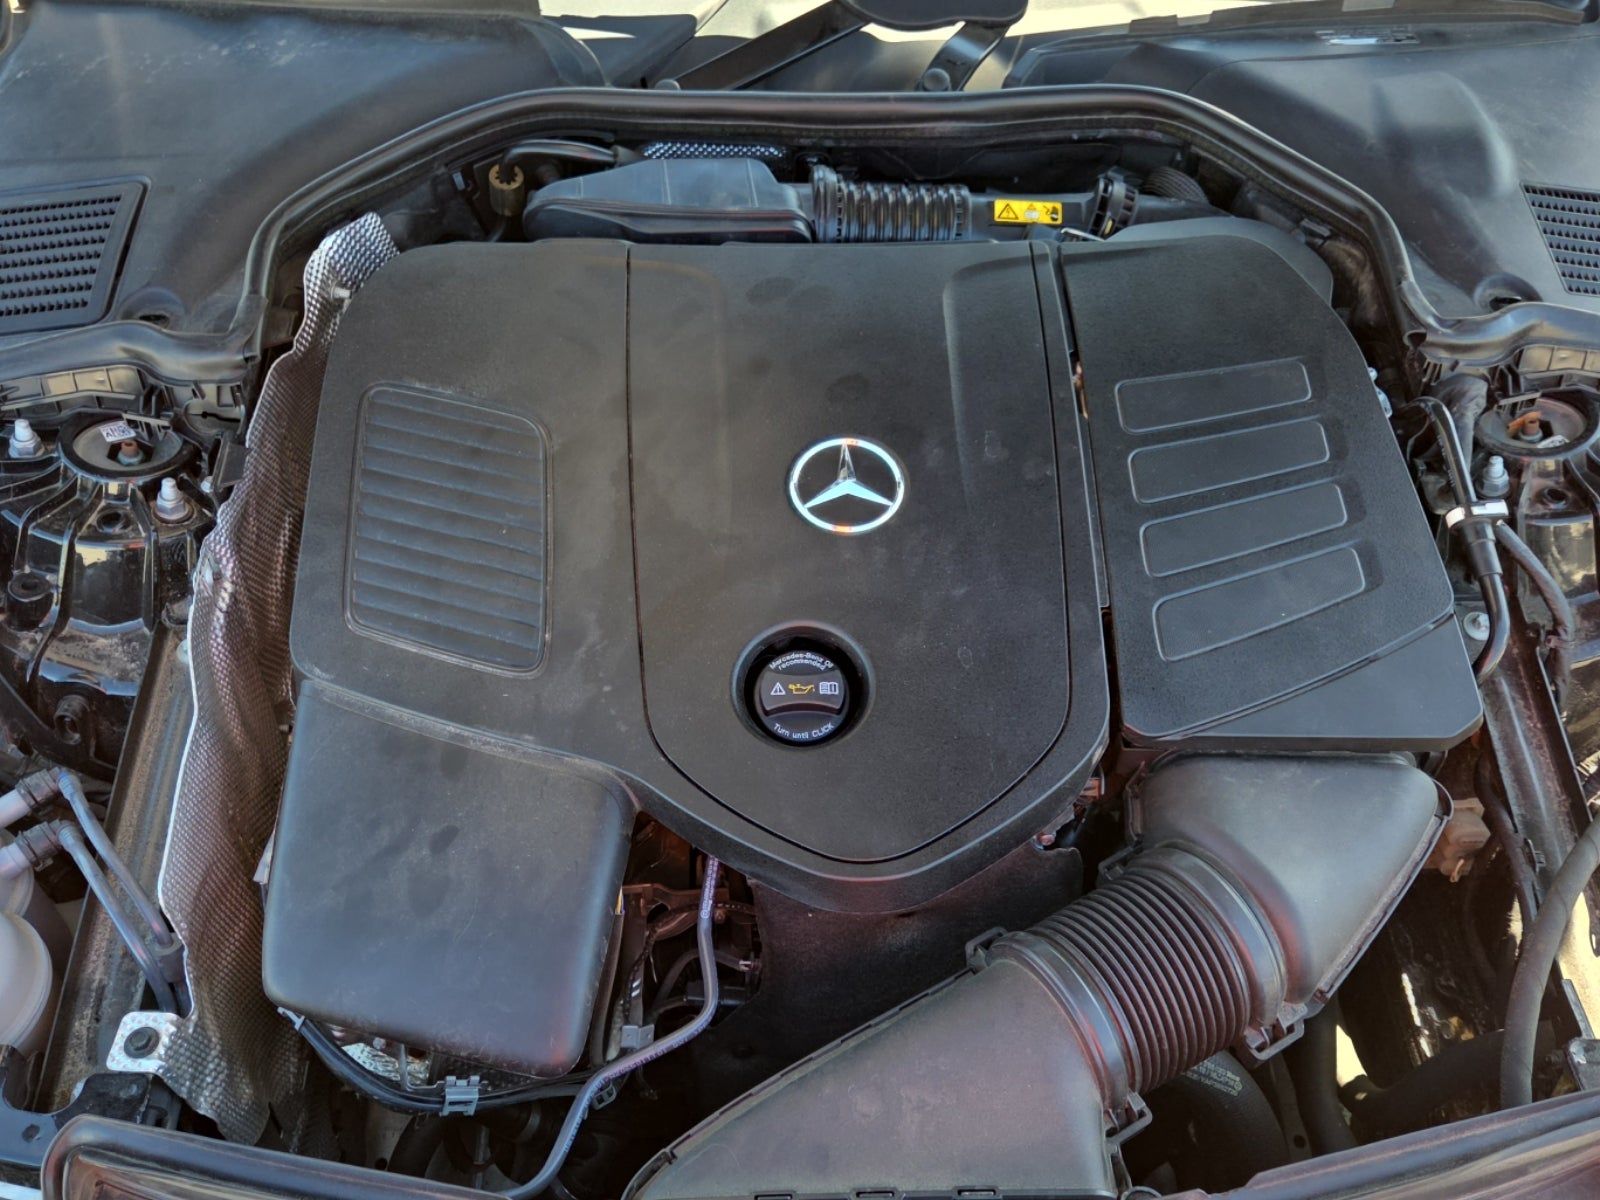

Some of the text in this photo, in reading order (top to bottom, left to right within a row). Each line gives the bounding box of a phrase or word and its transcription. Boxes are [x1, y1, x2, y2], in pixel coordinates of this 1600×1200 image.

[769, 652, 823, 669] Mercedes-Benz
[778, 659, 825, 671] recommended
[774, 722, 834, 739] Turn until CLICK
